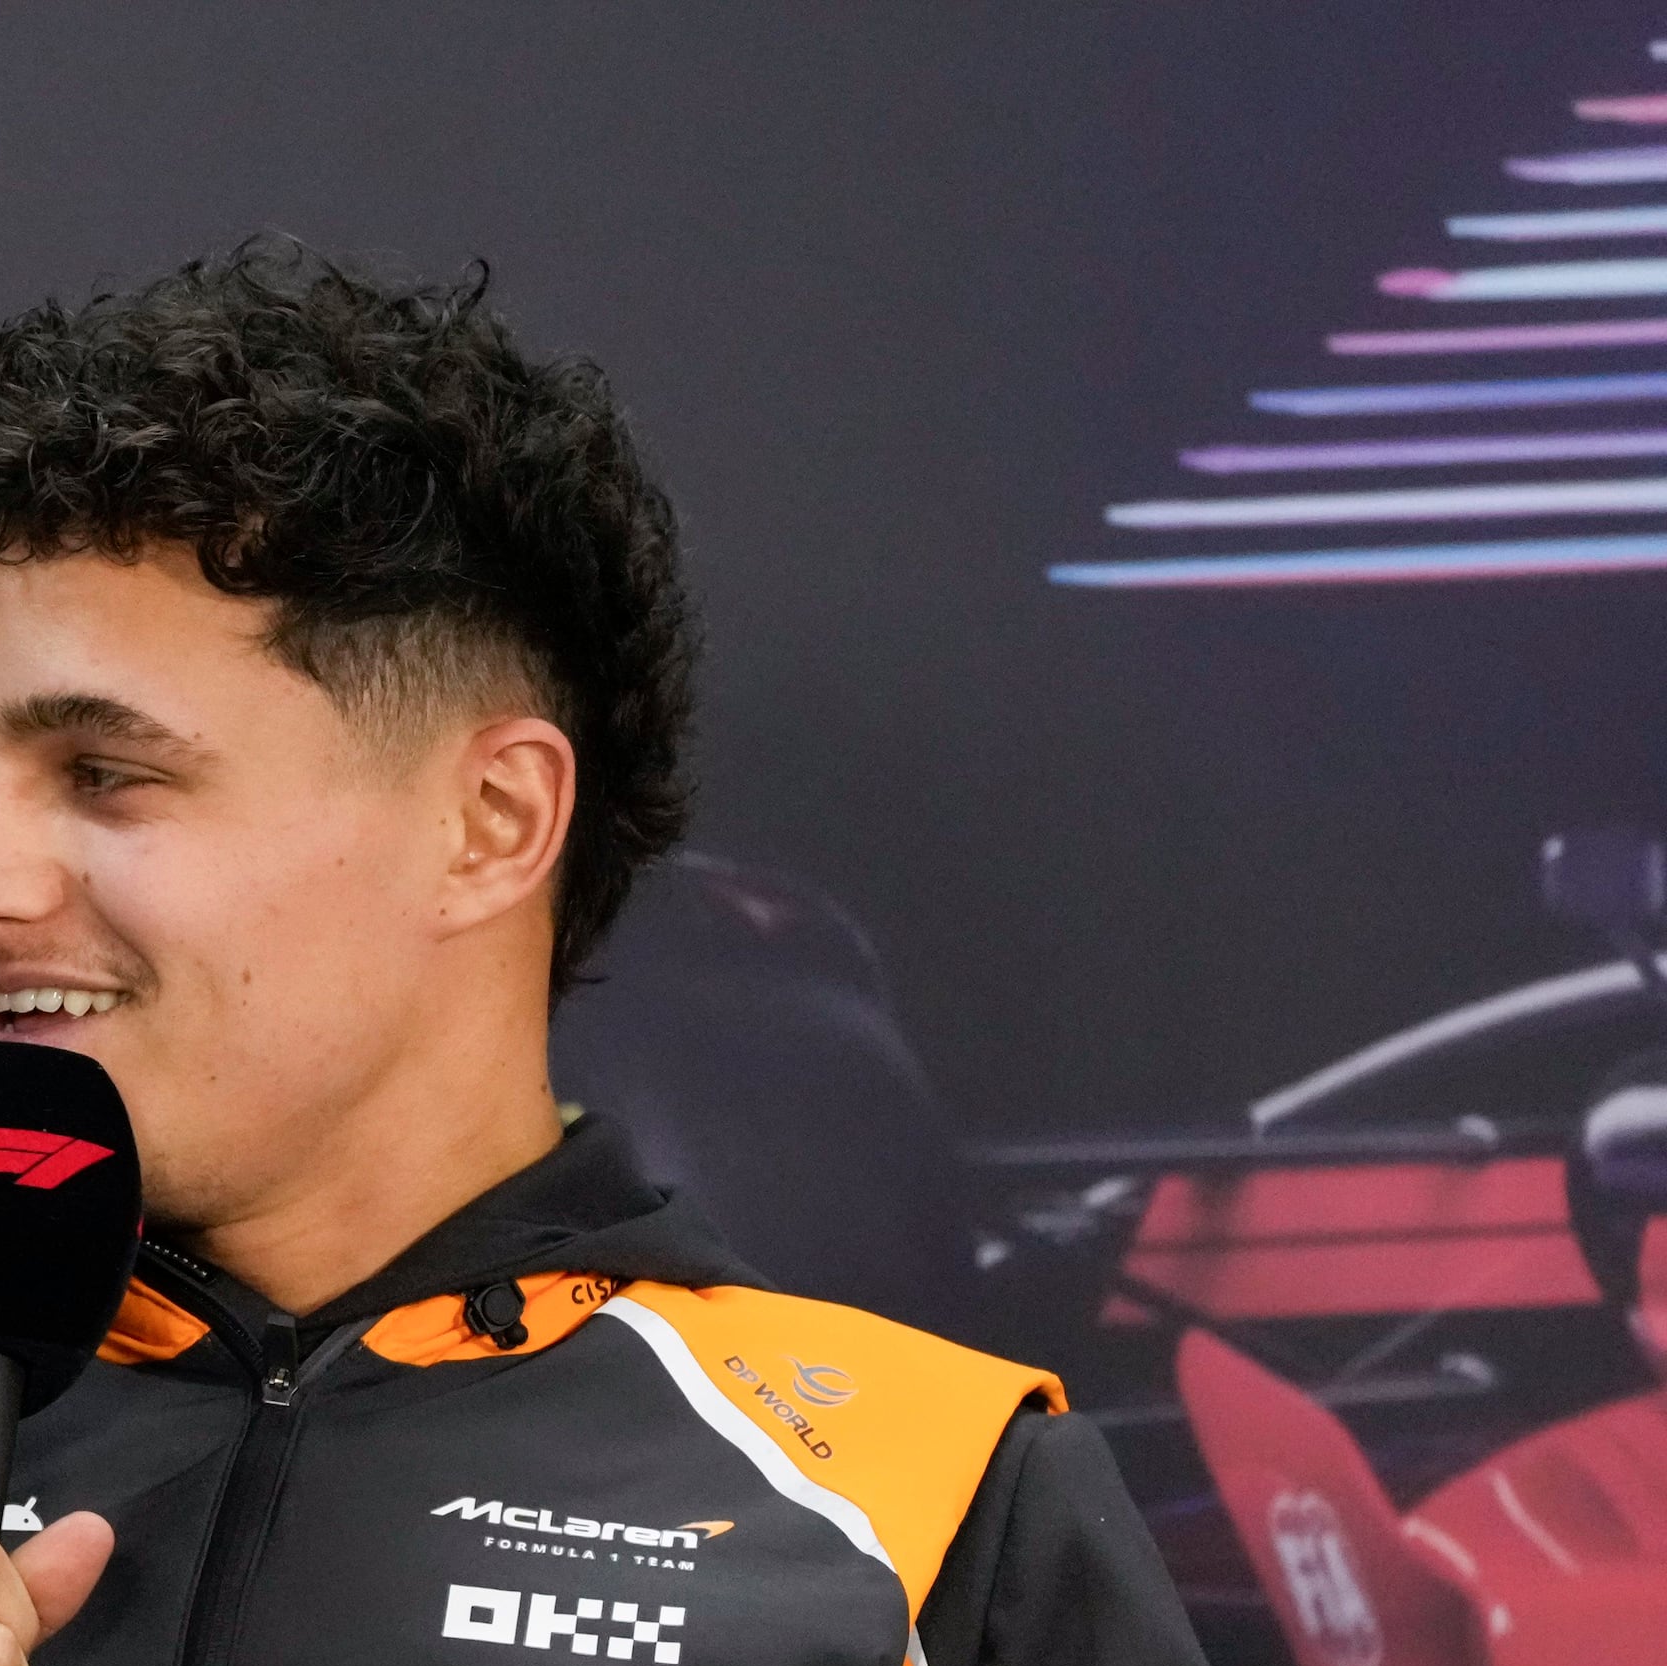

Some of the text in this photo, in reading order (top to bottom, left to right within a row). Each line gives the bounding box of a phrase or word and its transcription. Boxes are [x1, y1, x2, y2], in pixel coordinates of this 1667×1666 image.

[571, 1279, 615, 1305] CIS
[723, 1355, 833, 1460] DP WORLD
[430, 1497, 698, 1550] McLaren
[483, 1536, 696, 1572] FORMULA 1 TEAM
[441, 1583, 686, 1665] OKX
